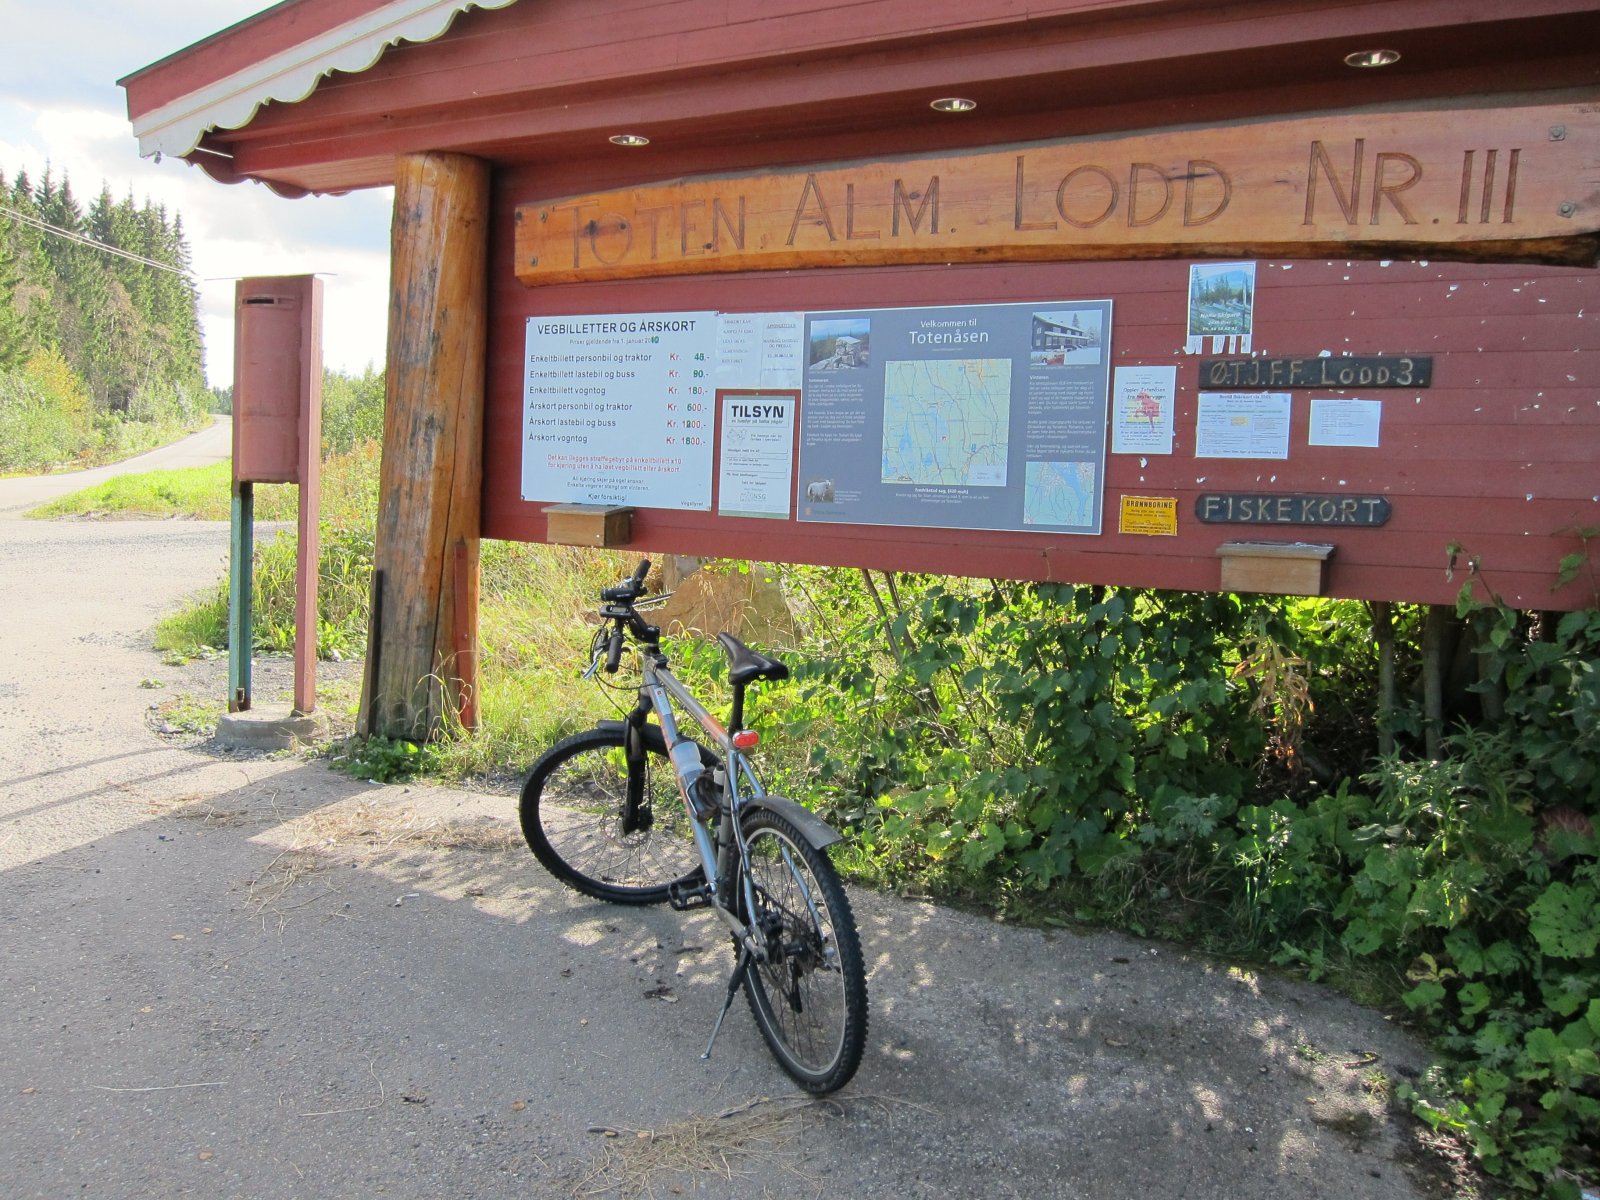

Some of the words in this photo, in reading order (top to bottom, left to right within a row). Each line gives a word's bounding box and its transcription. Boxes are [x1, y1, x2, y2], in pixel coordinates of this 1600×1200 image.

[552, 195, 746, 269] TOTEN
[1014, 155, 1233, 231] LODD
[537, 322, 617, 334] VEGBILLETTER
[619, 322, 636, 333] OG
[639, 320, 696, 332] ÅRSKORT
[920, 320, 967, 328] Velkommen
[968, 318, 977, 326] til
[908, 328, 989, 344] Totenåsen
[530, 354, 574, 363] Enkeltbillett
[576, 354, 612, 364] personbil
[613, 355, 623, 364] og
[625, 353, 652, 362] traktor
[669, 353, 682, 361] Kr.
[530, 370, 574, 379] Enkeltbillett
[575, 370, 602, 378] lastebil
[616, 370, 635, 378] buss
[669, 369, 681, 378] Kr.
[530, 386, 574, 394] Enkeltbillett
[574, 387, 606, 396] vogntog
[668, 386, 680, 394] Kr.
[529, 401, 557, 410] Årskort
[558, 402, 594, 412] personbil
[668, 403, 679, 411] Kr.
[732, 406, 784, 418] TILSYN
[529, 418, 556, 426] Årskort
[558, 418, 585, 426] lastebil
[598, 419, 616, 427] buss
[667, 420, 678, 428] Kr.
[528, 434, 556, 442] Årskort
[557, 435, 588, 443] vogntog
[666, 436, 677, 444] Kr.
[1126, 500, 1173, 508] BRØNNBORING
[1204, 496, 1381, 522] FISKEKORT
